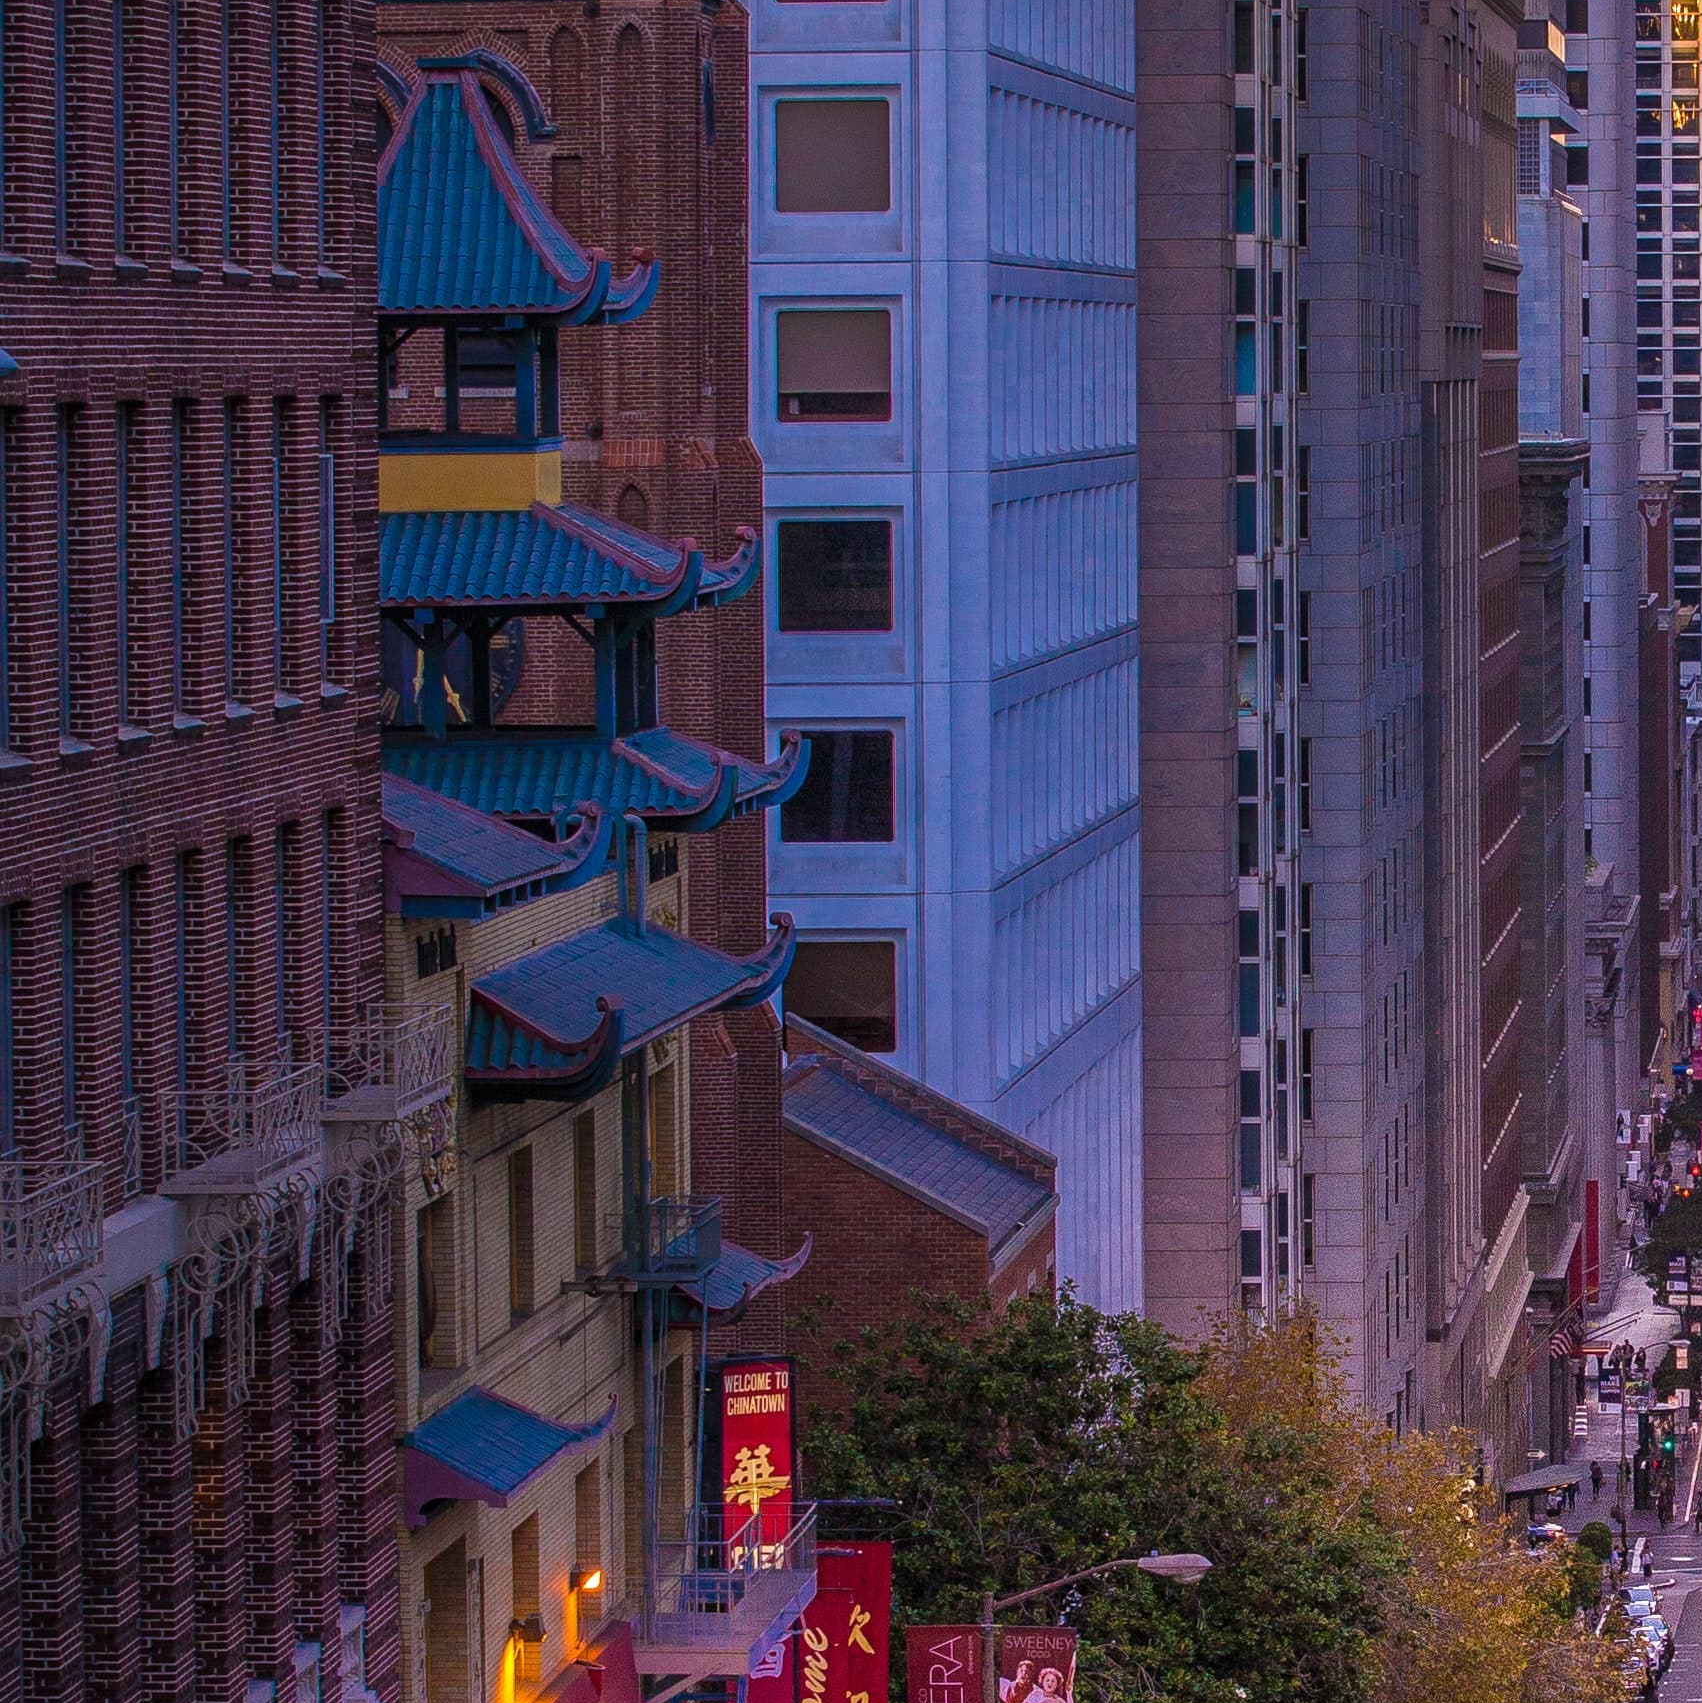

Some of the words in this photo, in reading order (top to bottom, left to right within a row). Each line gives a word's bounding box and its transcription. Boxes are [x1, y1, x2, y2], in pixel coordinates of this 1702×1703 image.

[724, 1373, 772, 1393] WELCOME
[775, 1371, 789, 1390] TO
[727, 1394, 786, 1416] CHINATOWN
[1005, 1635, 1073, 1650] SWEENEY
